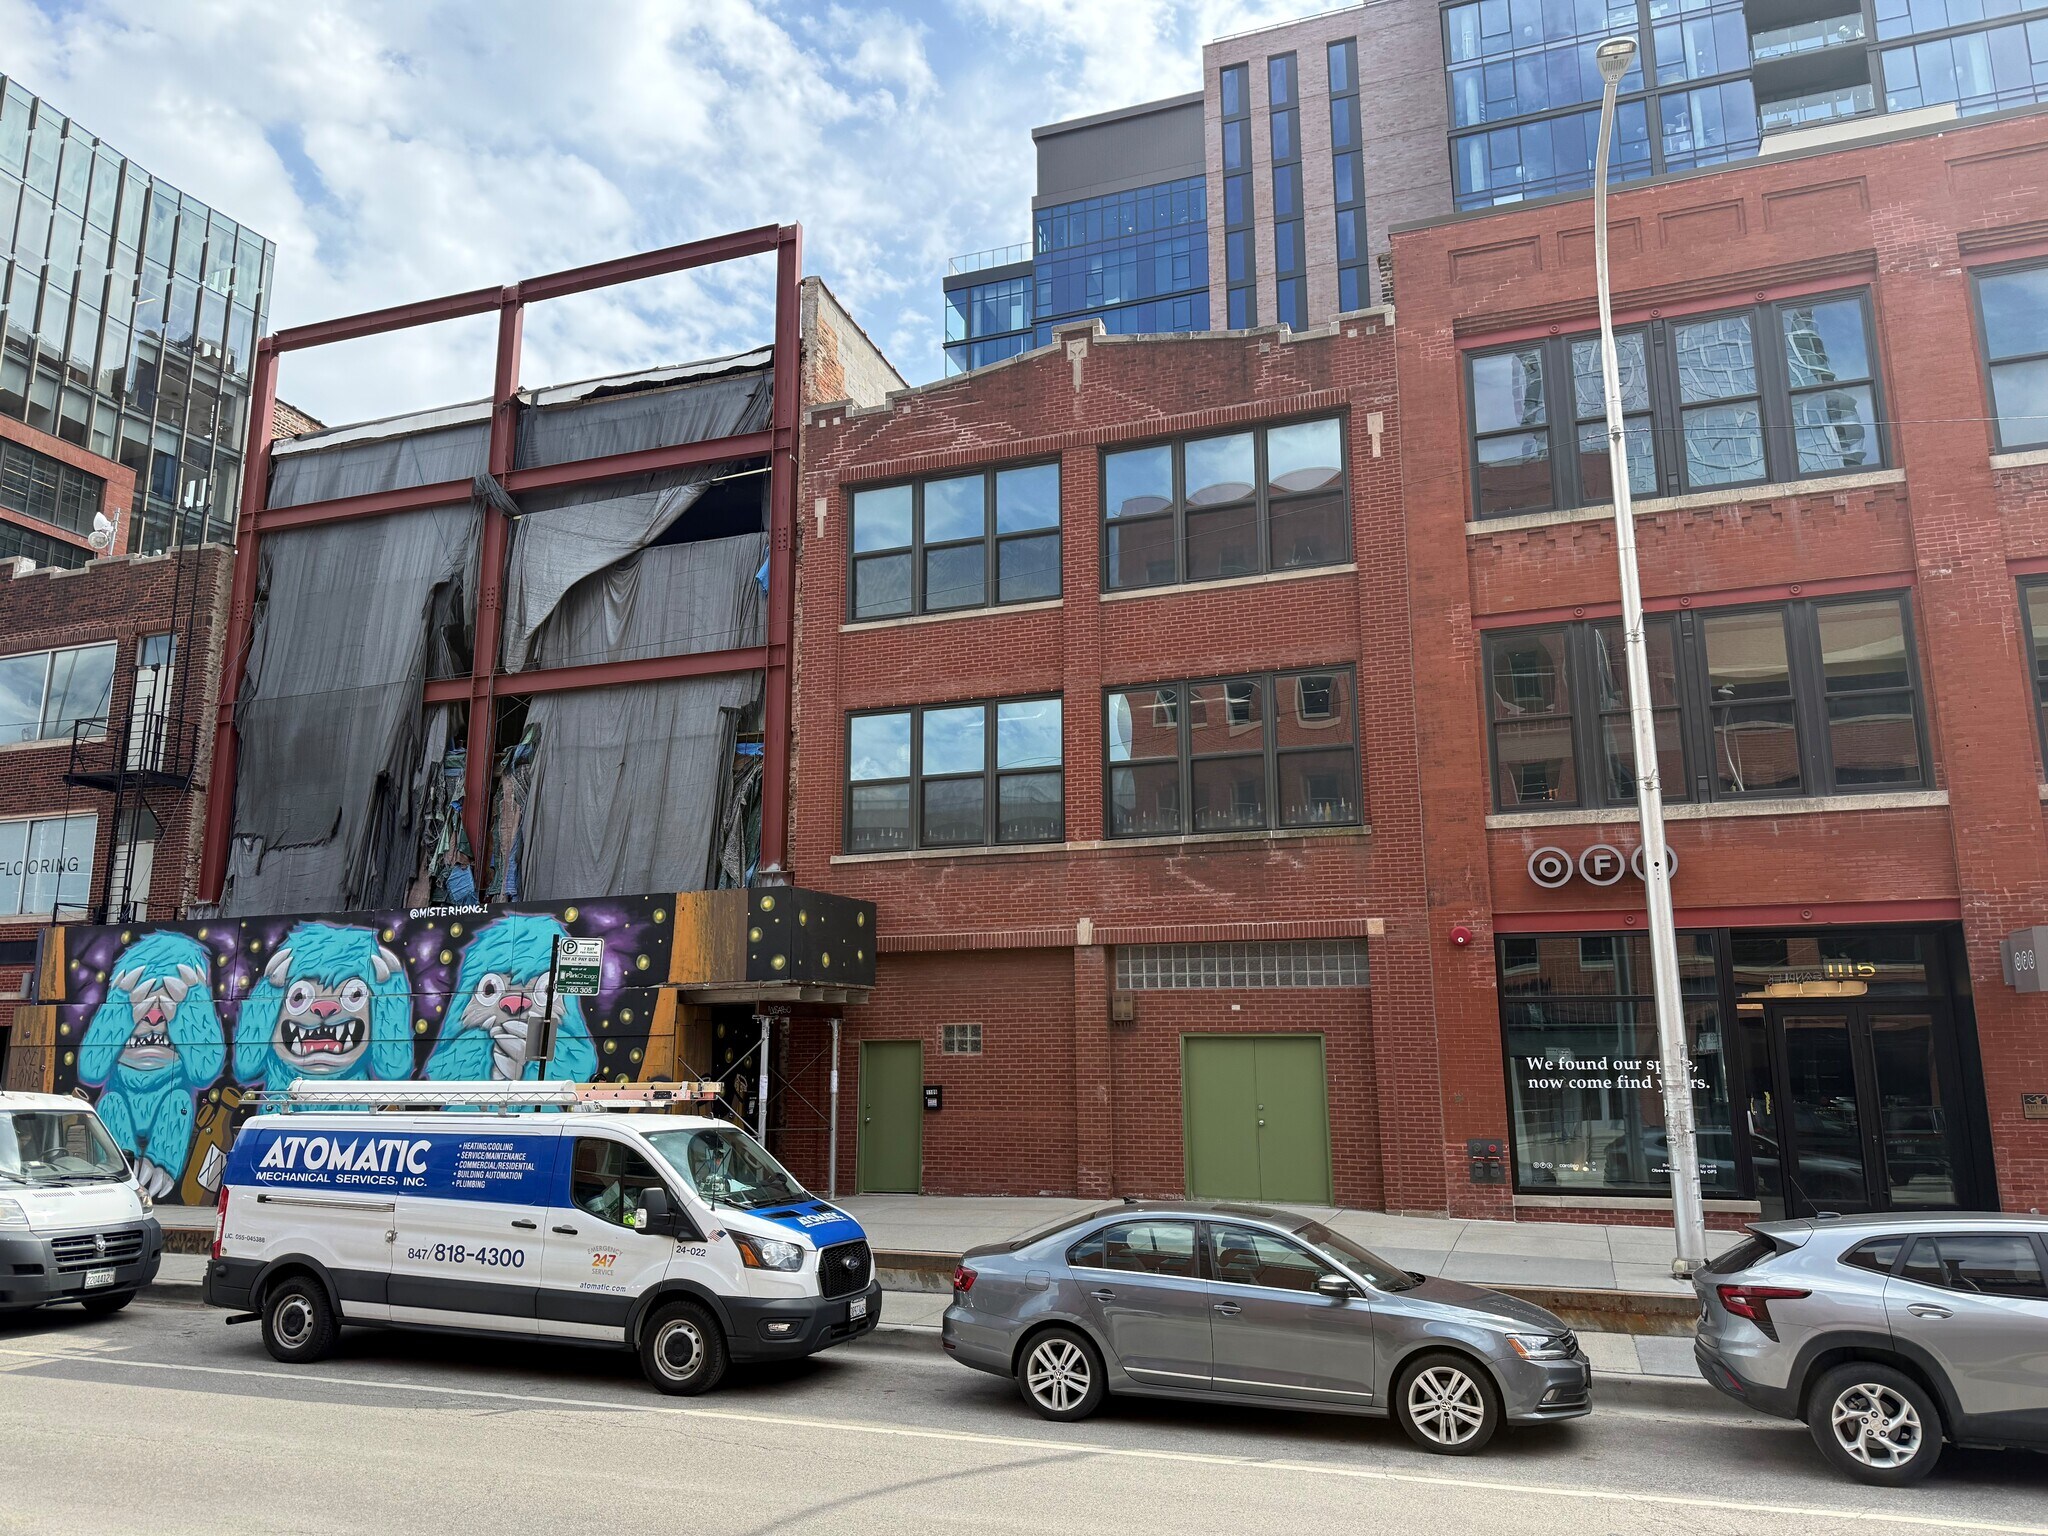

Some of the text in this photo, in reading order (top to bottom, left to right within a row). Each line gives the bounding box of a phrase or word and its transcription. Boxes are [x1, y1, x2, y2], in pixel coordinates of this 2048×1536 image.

[409, 903, 489, 920] @MISTERHONG1
[1526, 1057, 1554, 1070] We
[1558, 1057, 1608, 1070] found
[1613, 1060, 1642, 1070] our
[1528, 1078, 1563, 1089] now
[1568, 1078, 1612, 1089] come
[1617, 1076, 1653, 1089] find
[462, 1142, 514, 1151] HEATING/COOLING
[259, 1136, 432, 1174] ATOMATIC
[460, 1151, 527, 1161] SERVICE/MAINTENANCE
[458, 1160, 535, 1171] COMMERCIAL/RESIDENTIAL
[255, 1172, 428, 1187] MECHANICAL SERVICES, INC.
[457, 1170, 523, 1180] BUILDING AUTOMATION
[455, 1179, 486, 1189] PLUMBING
[587, 1245, 624, 1256] EMERGENCY
[676, 1245, 706, 1257] 24-022
[592, 1268, 614, 1276] SERVICE
[579, 1282, 627, 1292] atomatic.com
